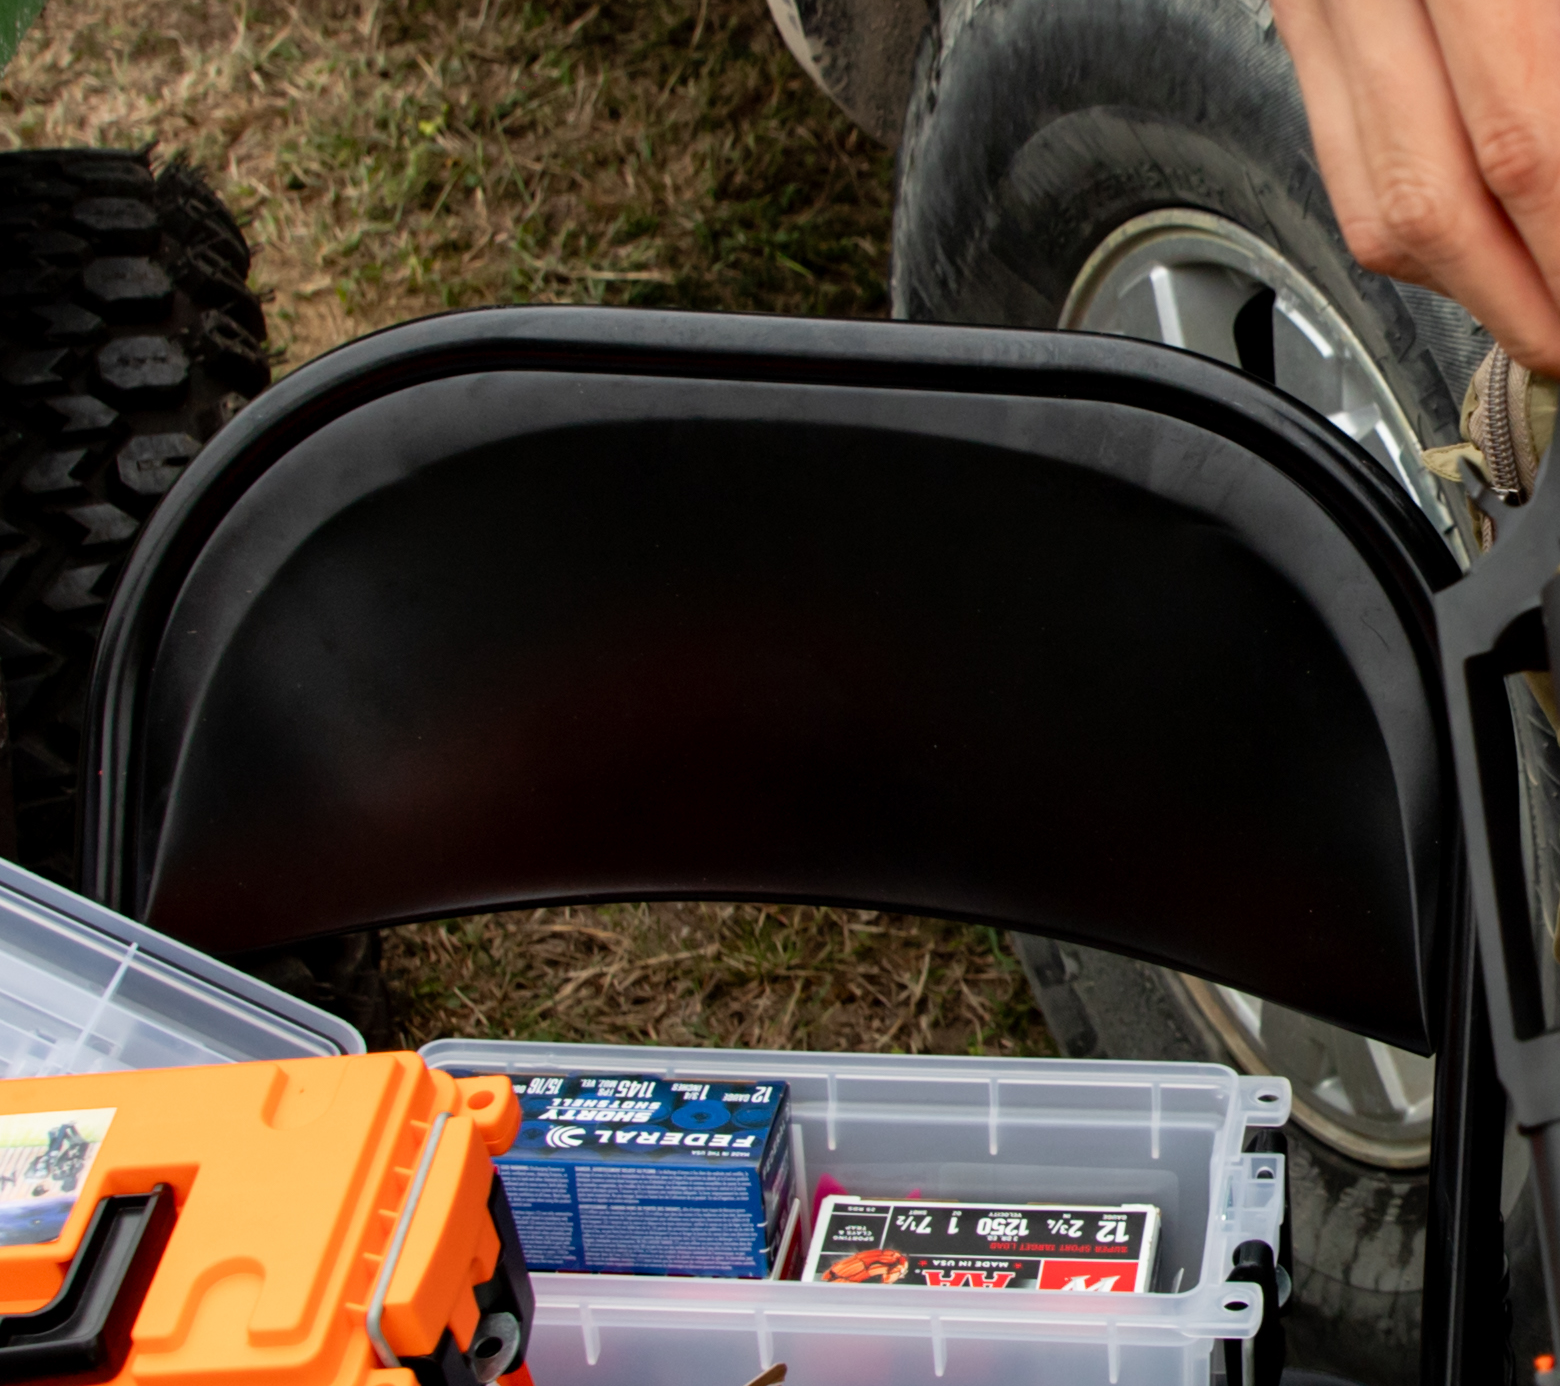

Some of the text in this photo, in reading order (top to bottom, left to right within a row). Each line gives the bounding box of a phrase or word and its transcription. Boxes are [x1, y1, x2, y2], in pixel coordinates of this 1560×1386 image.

[528, 1077, 564, 1095] 15/16
[615, 1080, 656, 1098] 1145
[700, 1084, 710, 1101] 1
[751, 1086, 773, 1103] 12
[550, 1097, 662, 1110] SHOTSHELL
[538, 1108, 654, 1123] SHORTY
[593, 1130, 756, 1148] FEDERAL
[948, 1216, 960, 1234] 1
[976, 1217, 1030, 1236] 1250
[1096, 1220, 1129, 1242] 12
[932, 1259, 1009, 1268] MADE IN USA
